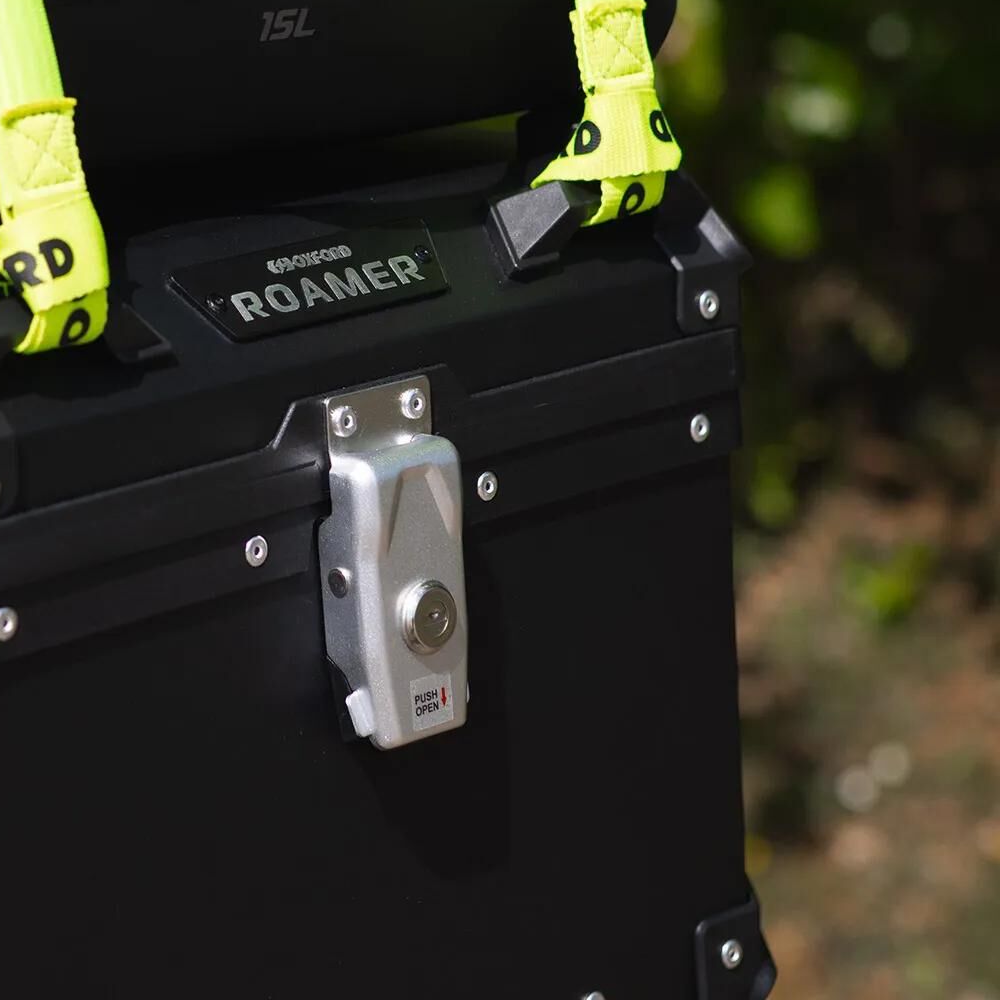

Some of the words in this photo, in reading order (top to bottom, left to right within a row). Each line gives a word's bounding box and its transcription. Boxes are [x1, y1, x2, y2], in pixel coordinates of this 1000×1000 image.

[259, 8, 316, 42] 15L
[291, 245, 352, 269] OXFORD
[230, 255, 426, 322] ROAMER
[414, 689, 438, 705] PUSH
[415, 701, 440, 717] OPEN
